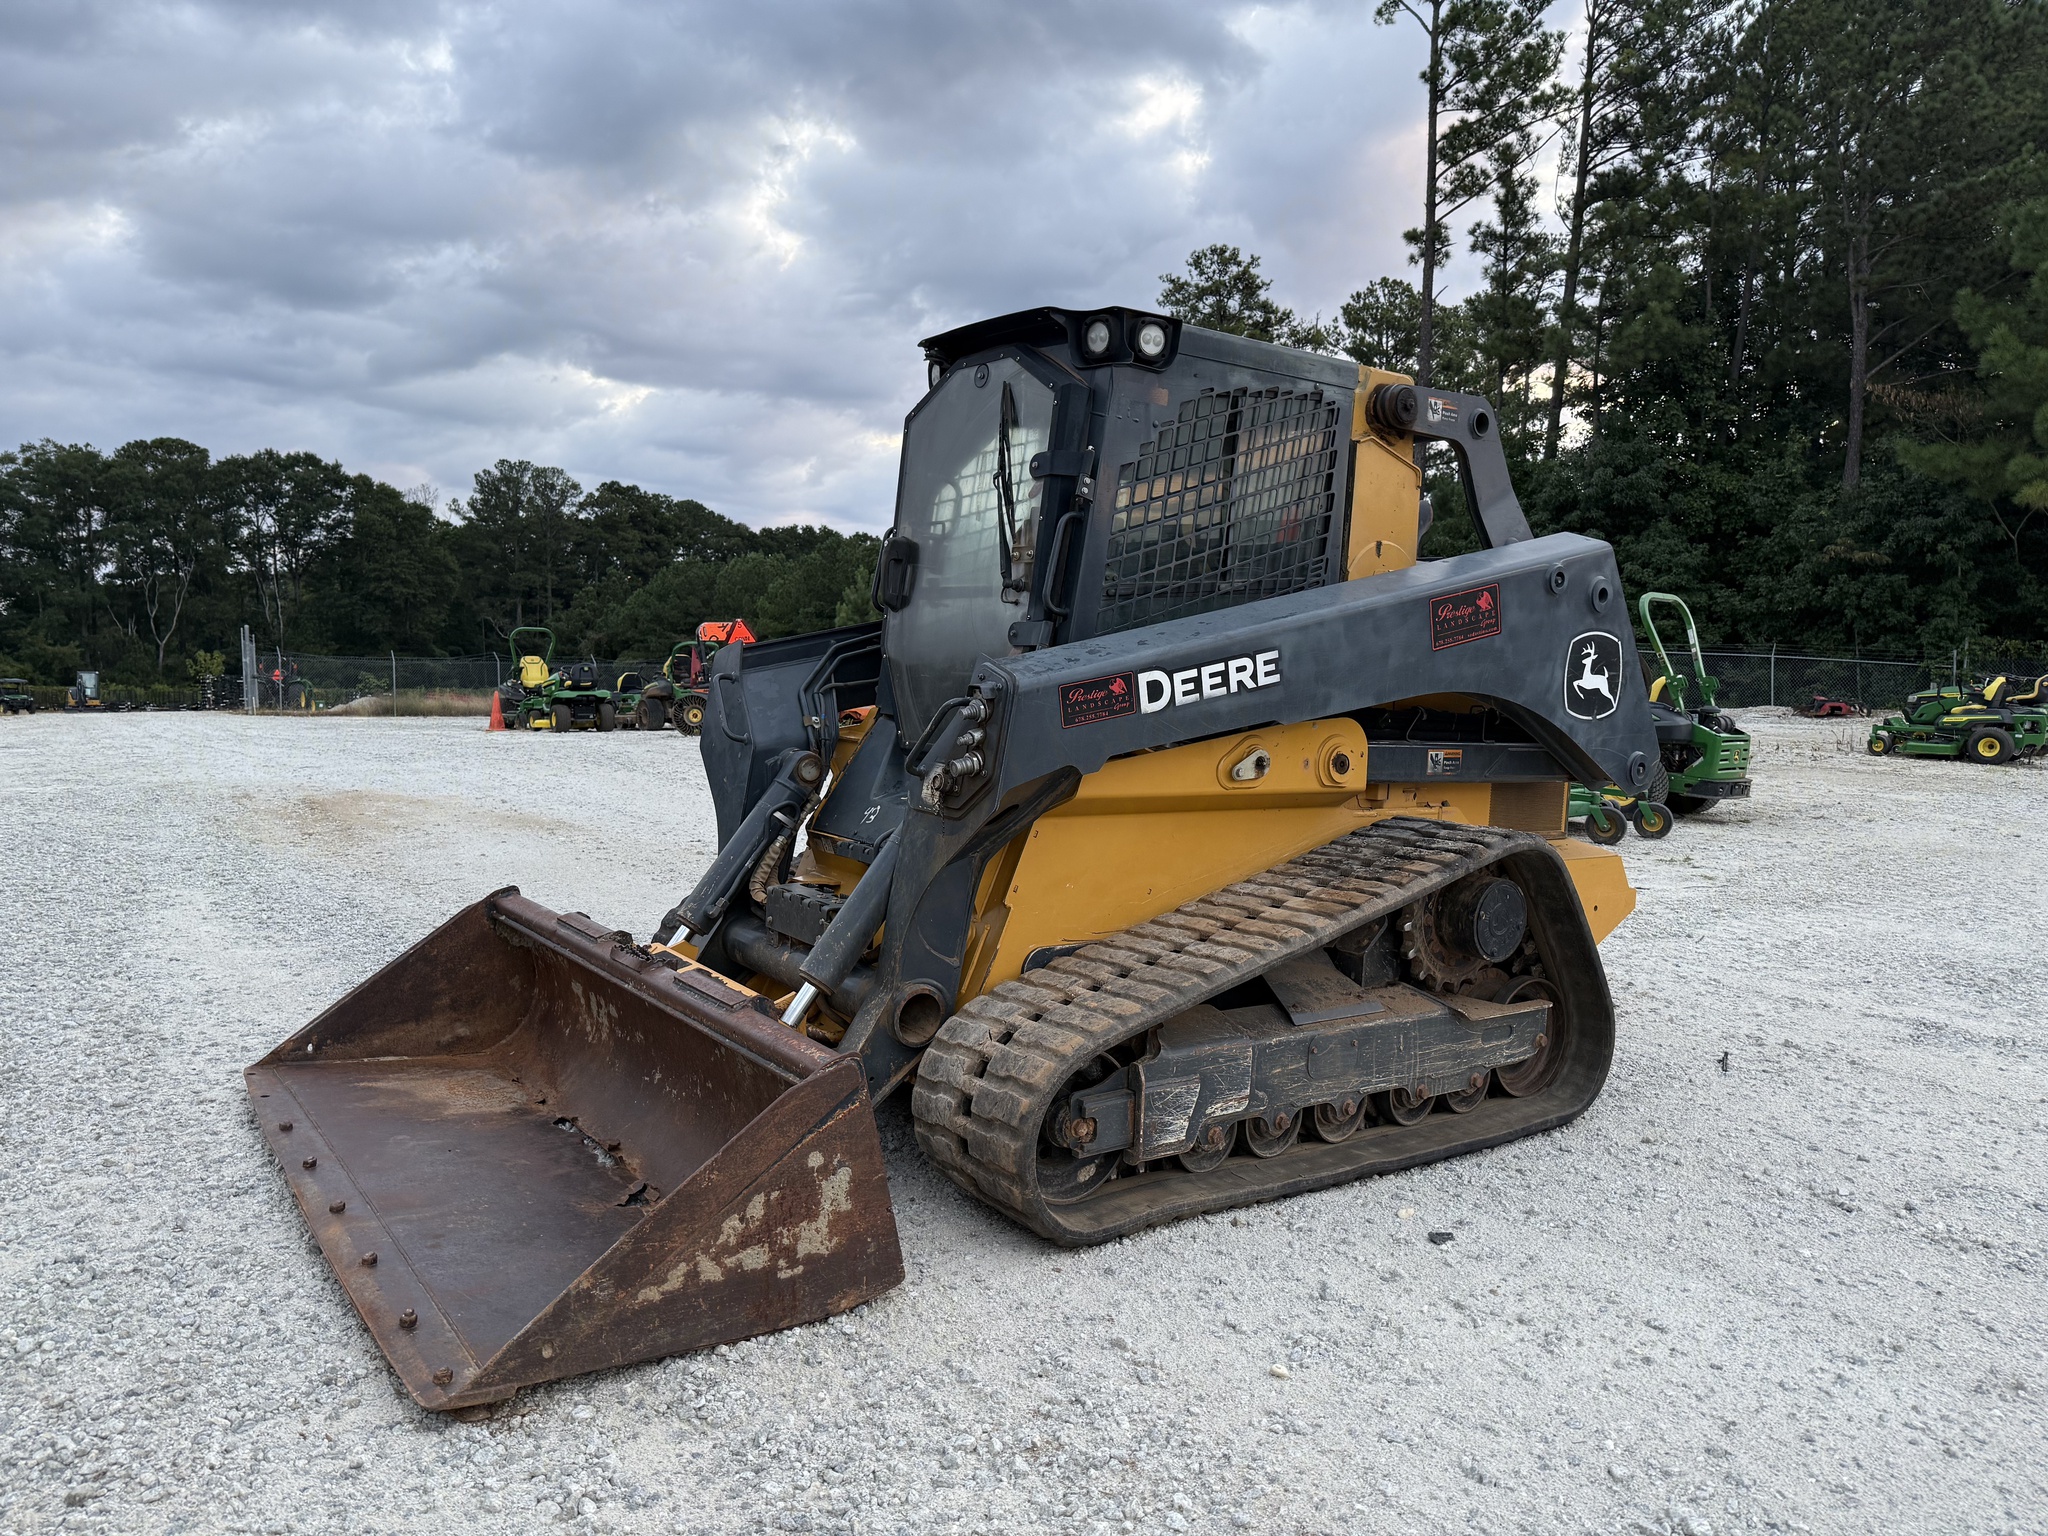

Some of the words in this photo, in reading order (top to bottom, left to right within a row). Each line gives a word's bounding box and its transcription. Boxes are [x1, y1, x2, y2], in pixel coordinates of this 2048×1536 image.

[1436, 603, 1476, 621] Prestige
[1436, 610, 1496, 630] LANDSCAPE
[1138, 650, 1280, 714] DEERE
[1066, 688, 1108, 704] Prestige
[1068, 695, 1130, 713] LANDSCAPE
